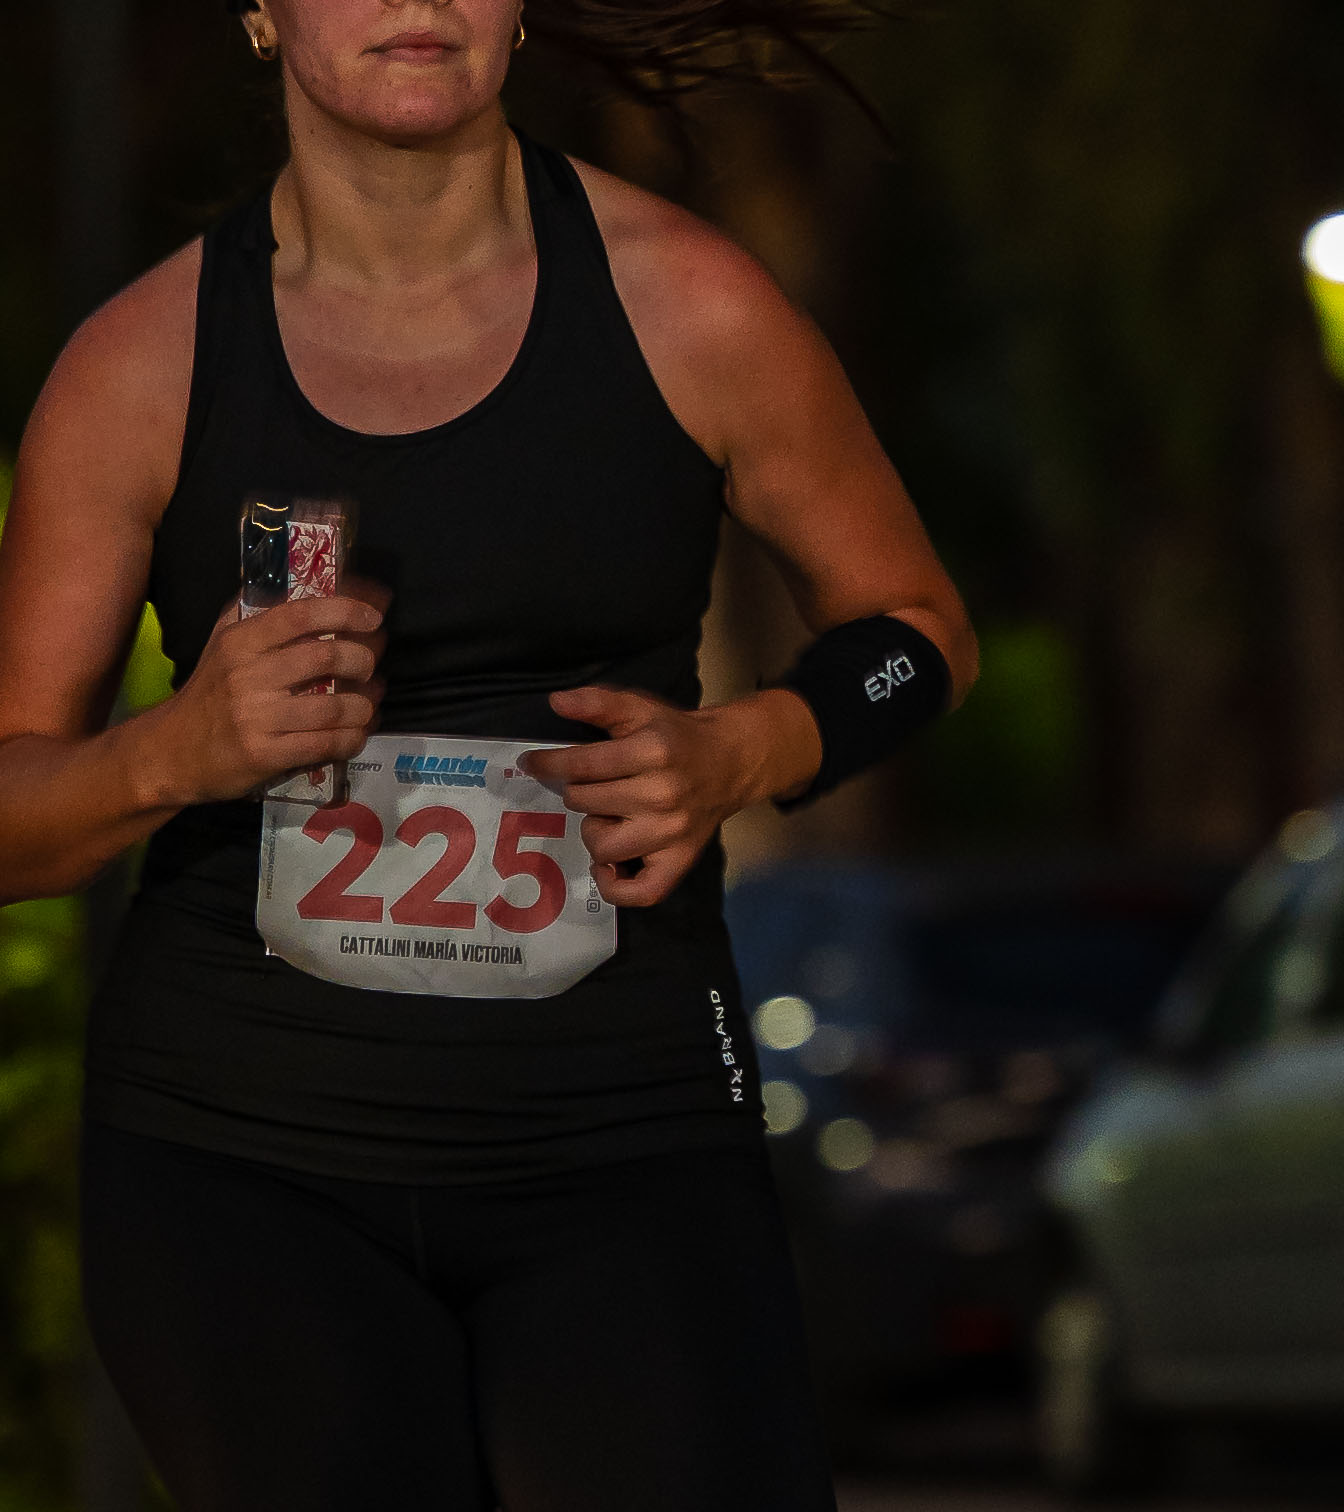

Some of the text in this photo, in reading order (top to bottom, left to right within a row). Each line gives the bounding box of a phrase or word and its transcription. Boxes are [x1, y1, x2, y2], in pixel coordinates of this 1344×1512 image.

[394, 753, 488, 775] MARATÓN
[297, 801, 567, 933] 225
[339, 935, 523, 965] CATTALINI MARÍA VICTORIA
